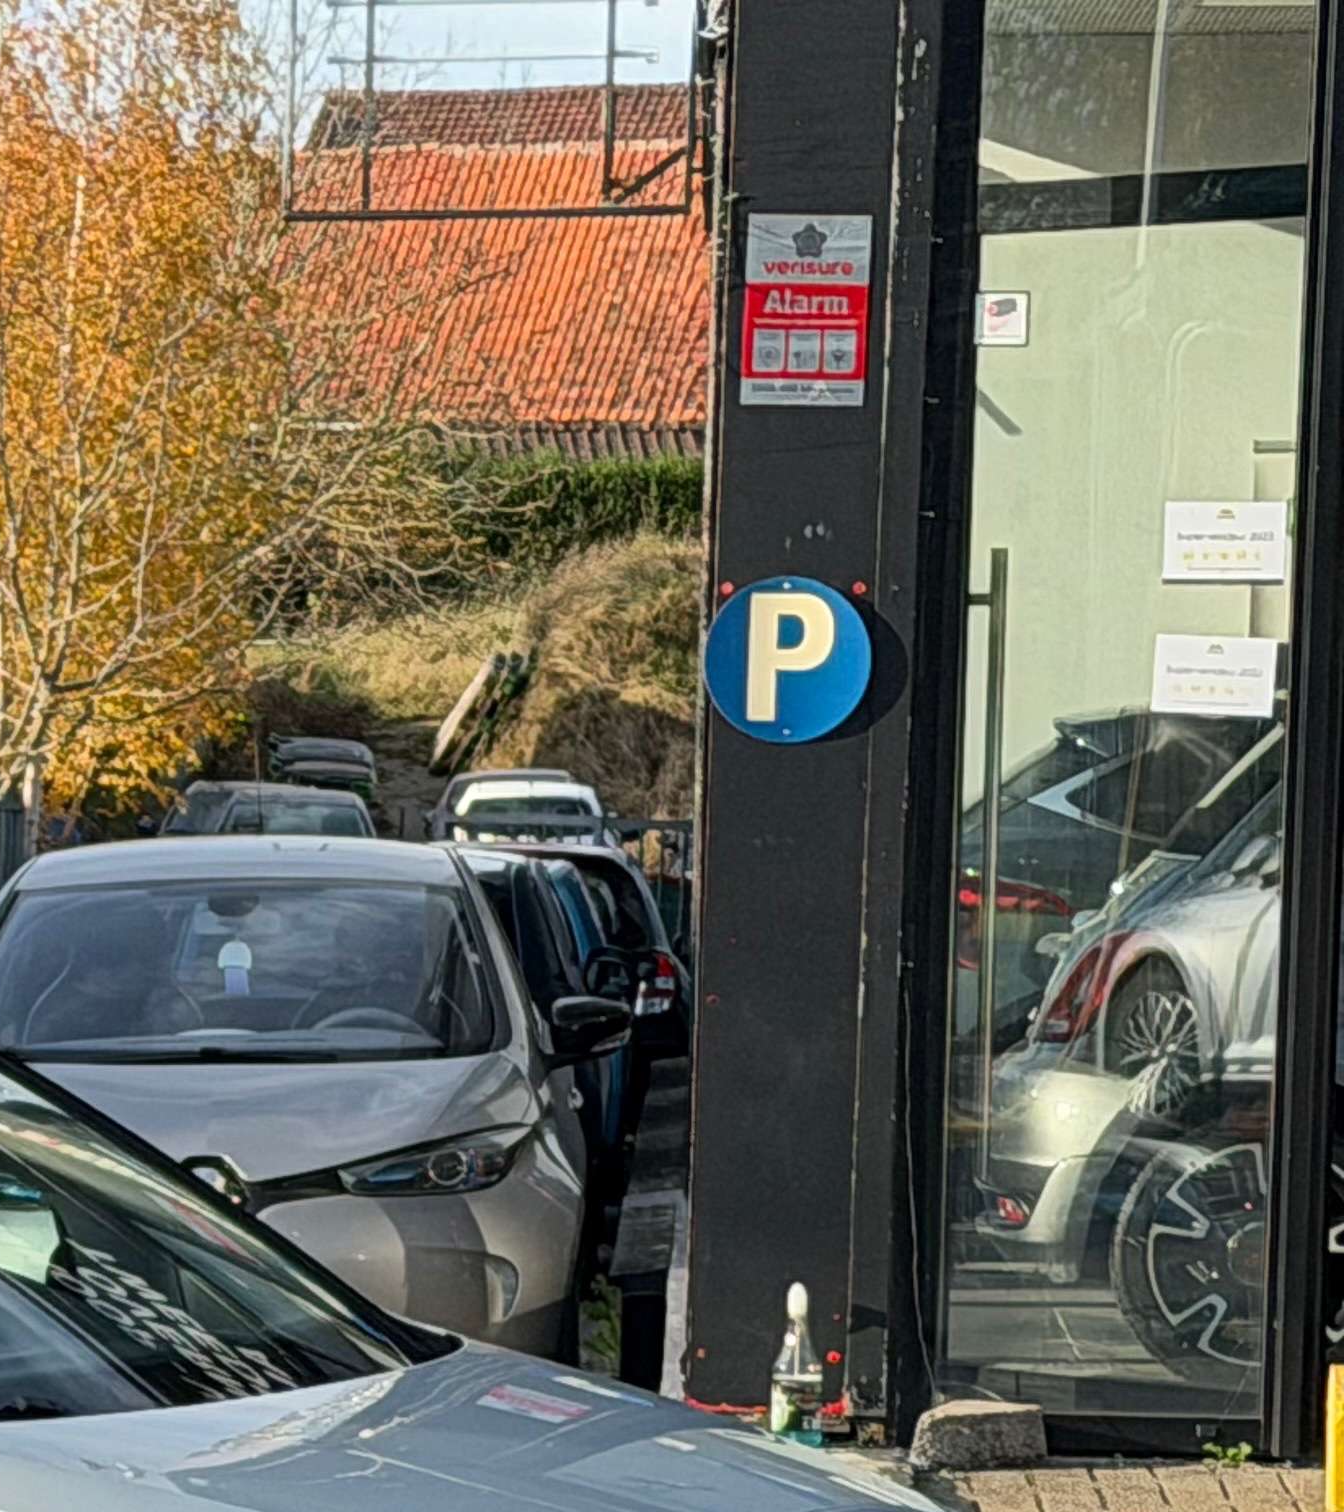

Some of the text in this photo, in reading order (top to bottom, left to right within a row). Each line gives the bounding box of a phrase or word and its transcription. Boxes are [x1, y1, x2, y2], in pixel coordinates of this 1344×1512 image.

[762, 260, 855, 277] verisure
[763, 287, 849, 315] Alarm
[746, 592, 835, 722] P
